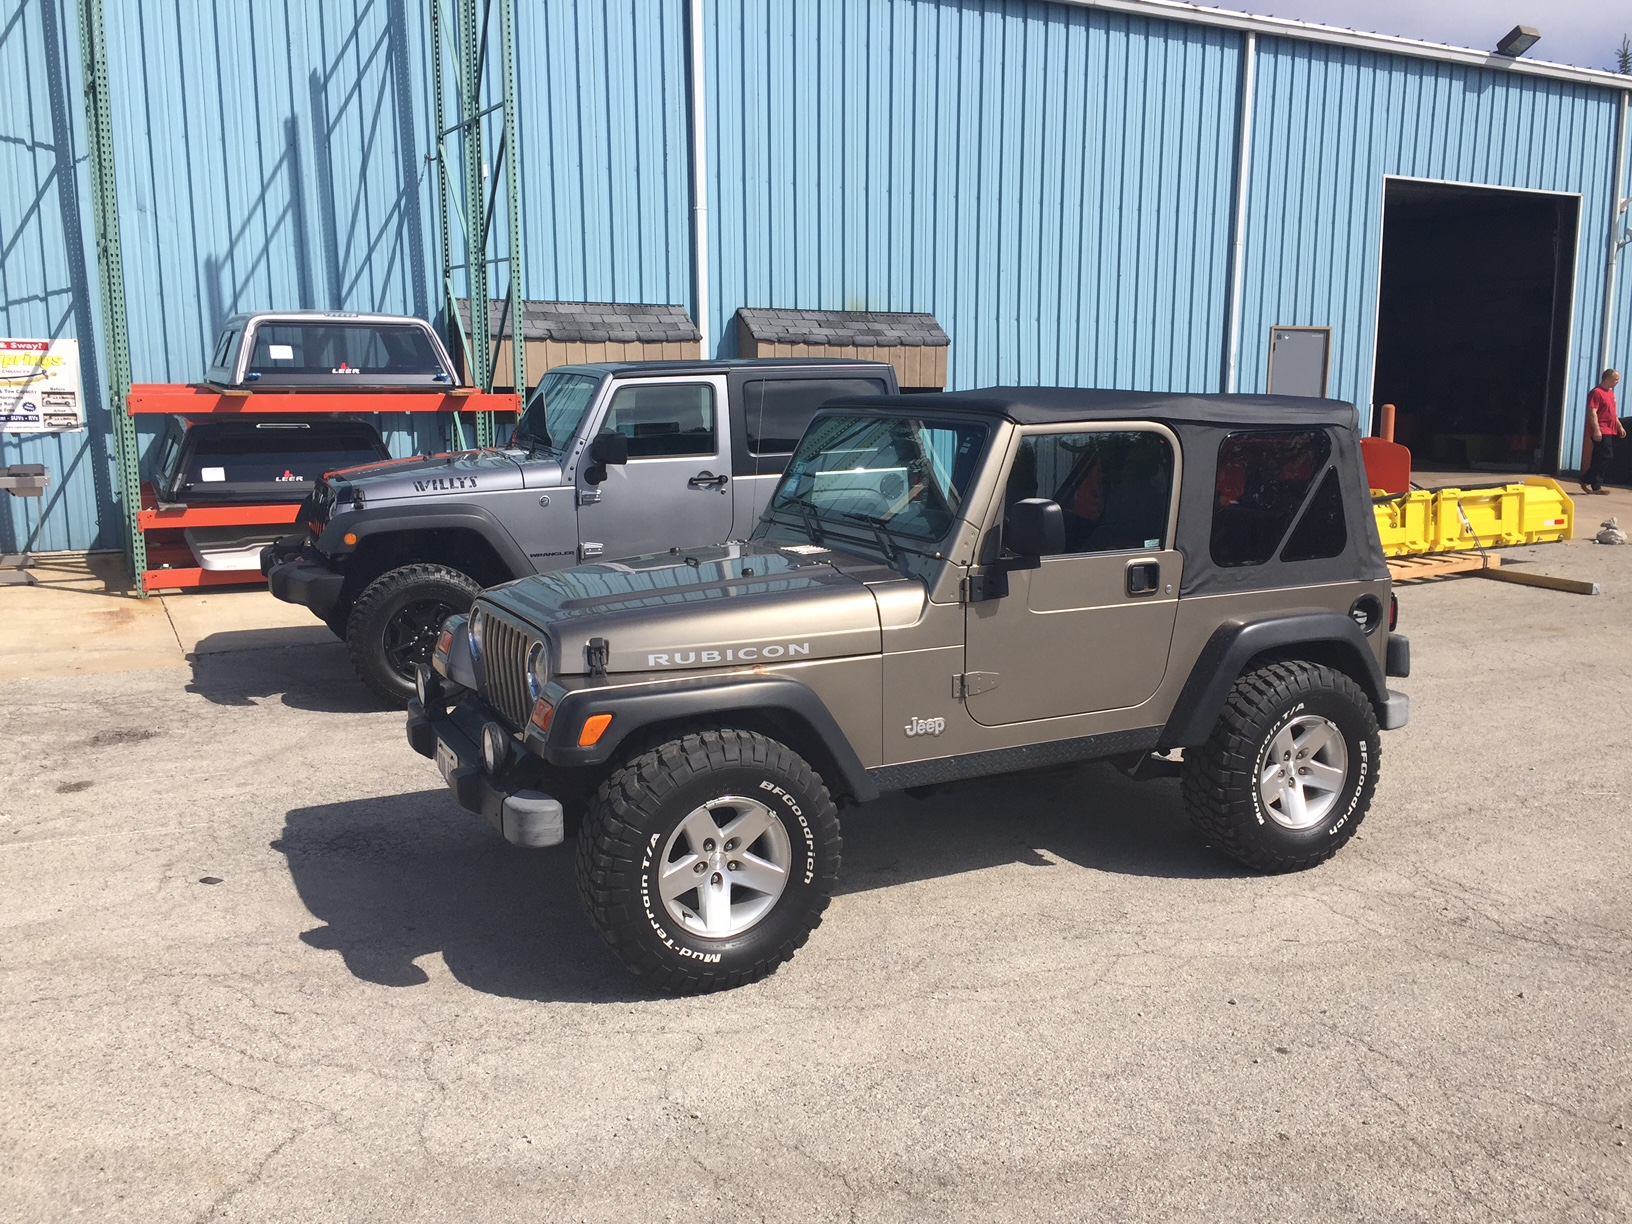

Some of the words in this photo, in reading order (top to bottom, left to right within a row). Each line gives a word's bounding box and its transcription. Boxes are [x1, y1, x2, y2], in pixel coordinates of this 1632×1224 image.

[11, 342, 42, 351] Sway?
[412, 476, 478, 492] WILLYS
[529, 550, 575, 558] WRANGLER
[648, 642, 810, 666] RUBICON
[904, 715, 946, 737] Jeep
[1251, 721, 1281, 826] Mud-Terrain
[1282, 702, 1305, 719] T/A
[1328, 739, 1368, 836] BFGoodrich
[759, 779, 817, 885] BFGoodrich
[641, 832, 661, 870] T/A
[640, 875, 722, 964] Mud-Terrain
